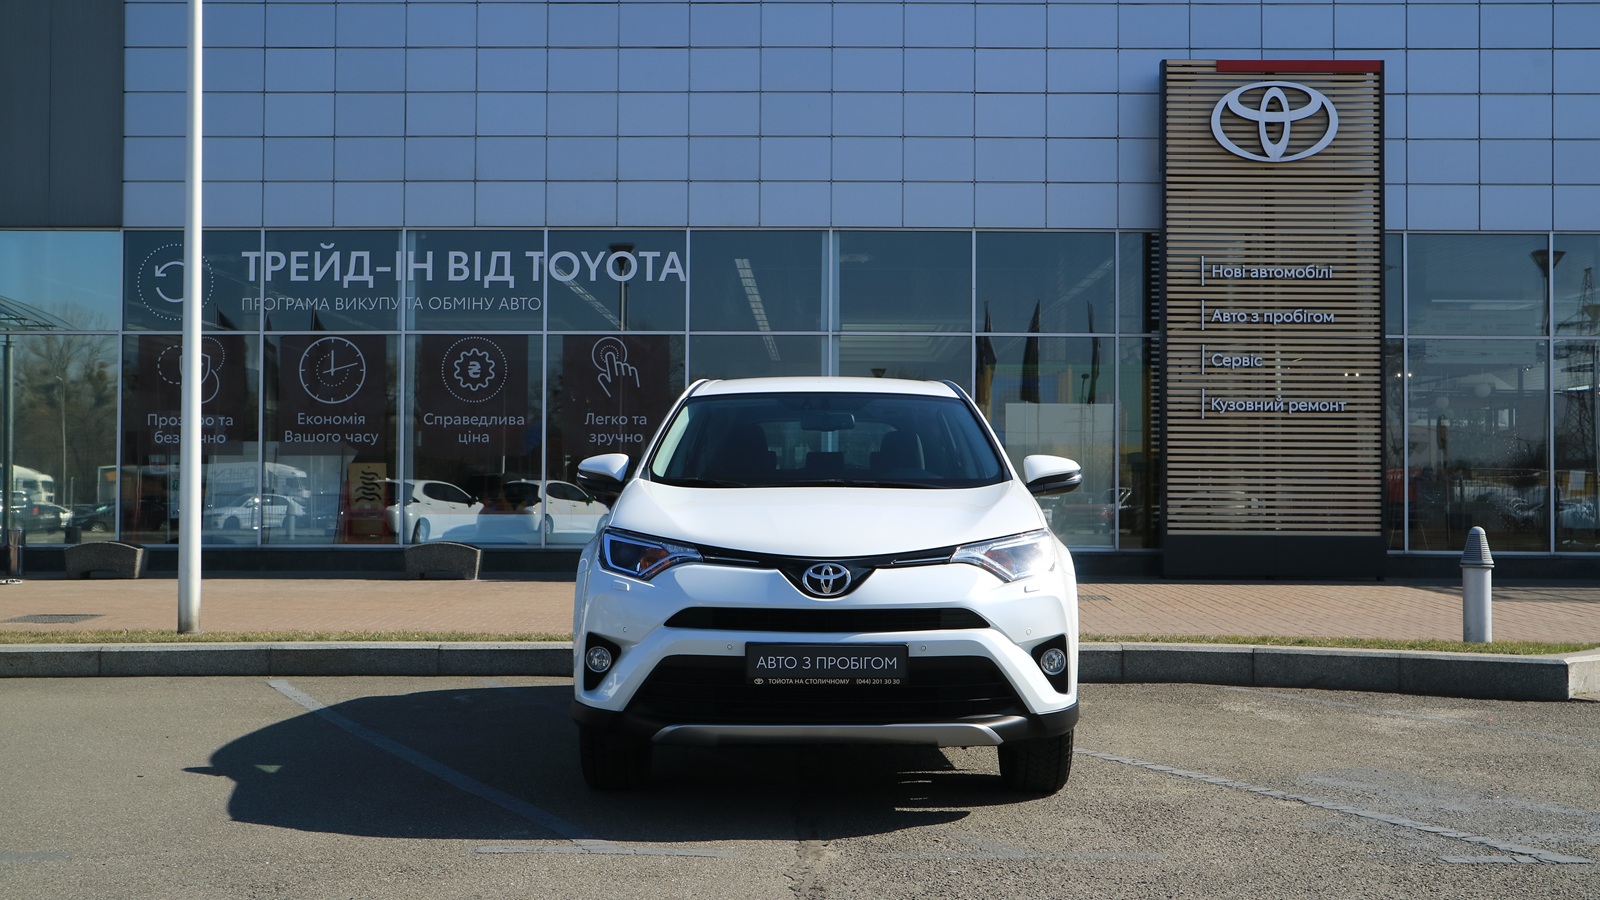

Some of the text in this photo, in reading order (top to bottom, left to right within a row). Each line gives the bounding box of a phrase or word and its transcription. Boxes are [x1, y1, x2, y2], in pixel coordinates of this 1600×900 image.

[241, 243, 686, 288] ТРЕЙД-ІН ВІД TOYOTA
[1211, 264, 1333, 279] Нові автомобілі
[242, 297, 542, 311] ПРОГРАМА ВИКУПУ ТА ОБМІНУ АВТО
[1211, 309, 1335, 325] Авто з пробігом
[1211, 353, 1263, 369] Сервіс
[1211, 397, 1347, 414] Кузовний ремонт
[218, 416, 234, 426] та
[297, 412, 365, 425] Економія
[423, 412, 525, 427] Справедлива
[585, 413, 647, 425] Легко та
[284, 431, 379, 445] Вашого часу
[458, 431, 490, 444] ціна
[589, 433, 643, 445] зручно
[756, 656, 897, 670] АВТО З ПРОБІГОМ
